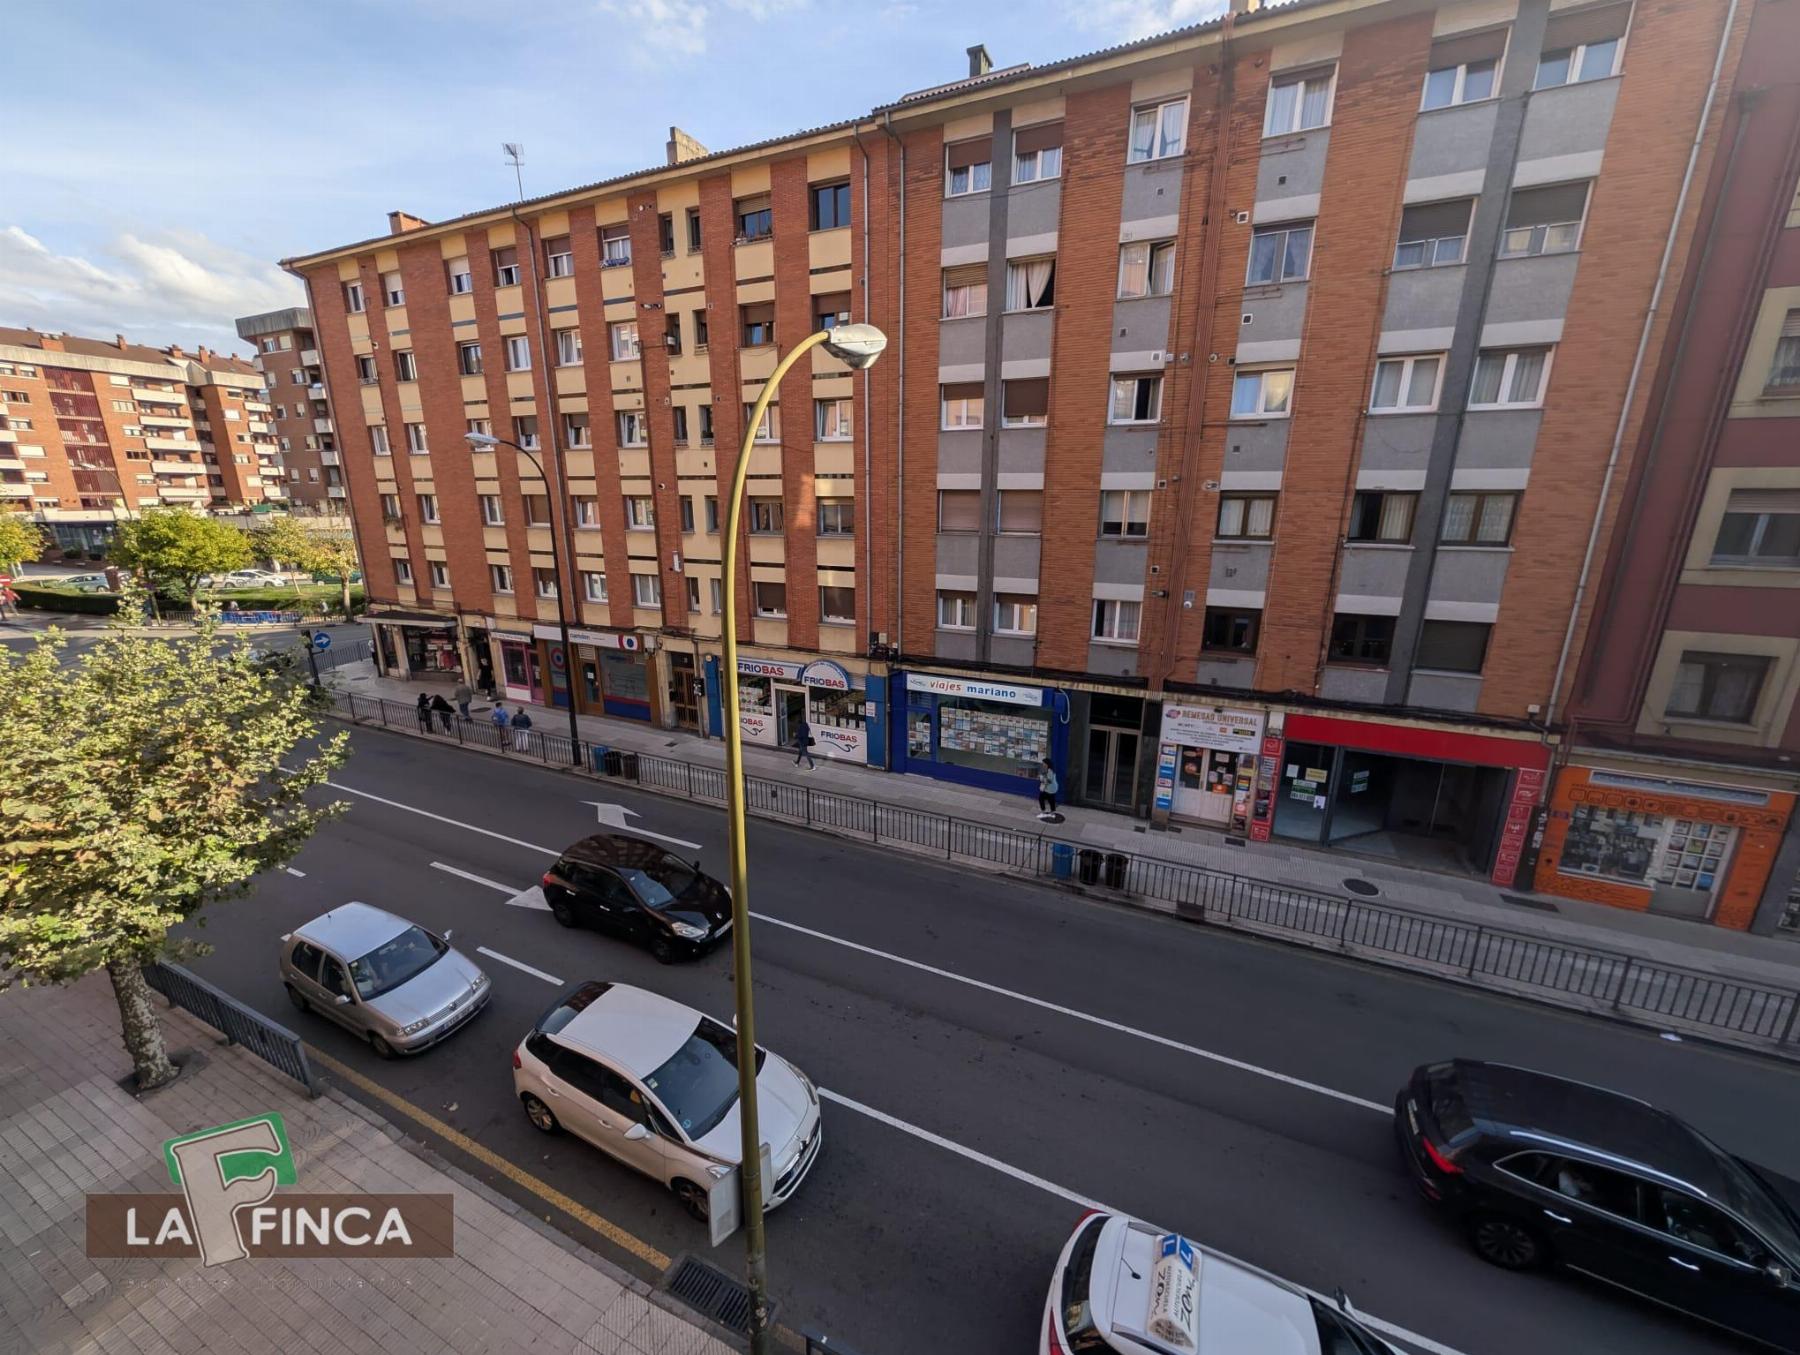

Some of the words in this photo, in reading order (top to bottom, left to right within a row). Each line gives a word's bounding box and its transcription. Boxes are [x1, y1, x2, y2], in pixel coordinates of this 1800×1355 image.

[738, 662, 785, 676] FRIOBAS
[804, 675, 845, 689] FRIOBAS
[930, 680, 961, 692] viajes
[967, 685, 1016, 698] mariano
[820, 730, 858, 743] FRIOBAS
